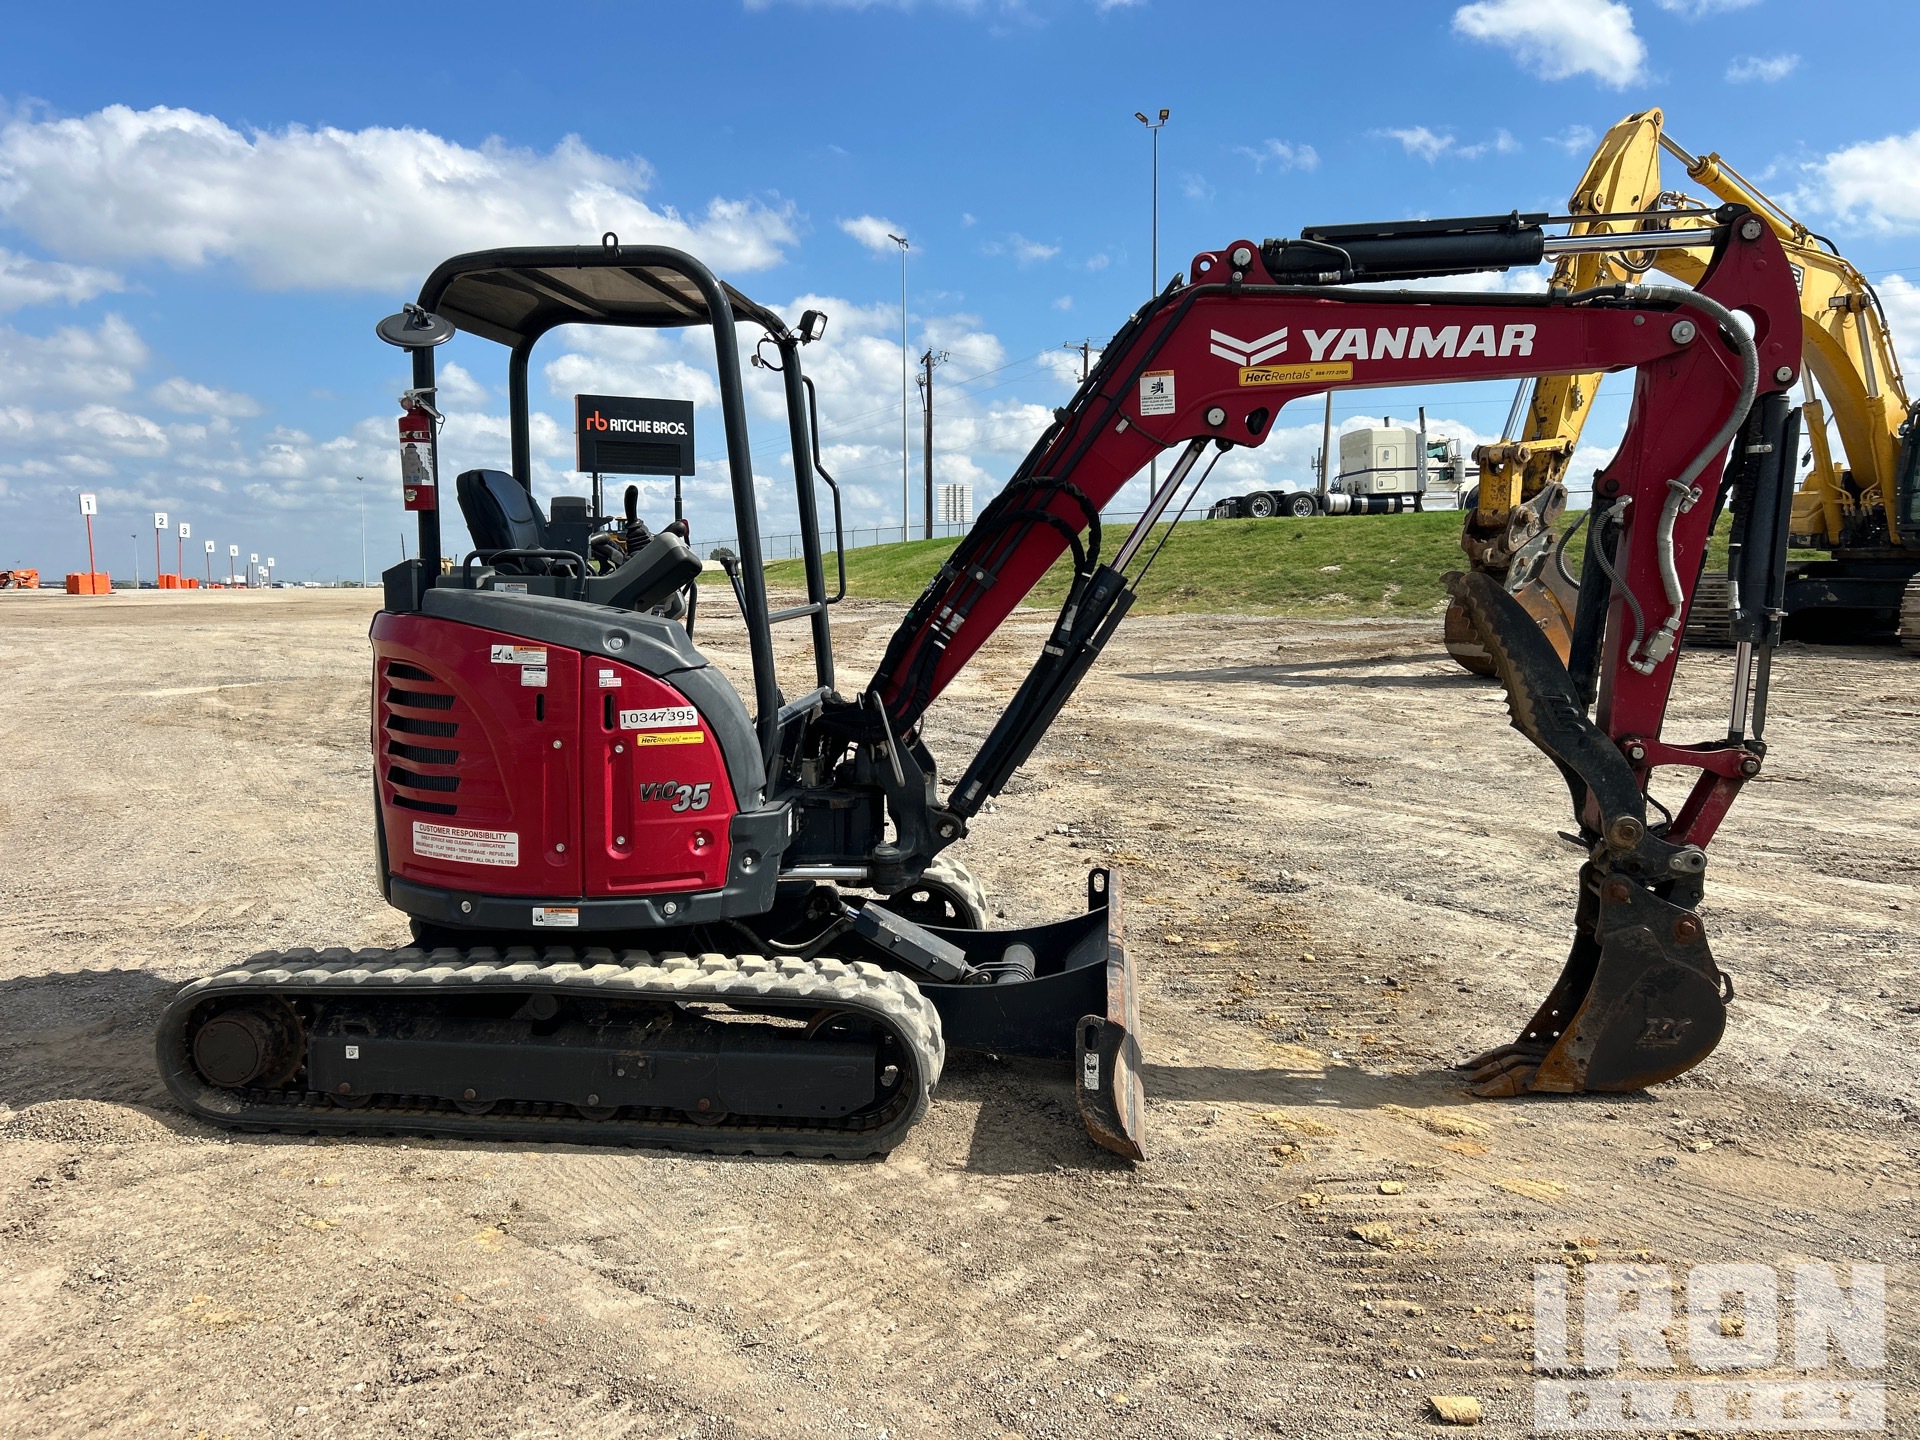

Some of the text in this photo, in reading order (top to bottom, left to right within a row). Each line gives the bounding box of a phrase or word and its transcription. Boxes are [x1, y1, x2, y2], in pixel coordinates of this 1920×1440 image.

[1302, 324, 1537, 362] YANMAR
[586, 410, 688, 435] rb RITCHIE BROS.
[86, 501, 91, 511] 1
[158, 518, 165, 526] 2
[621, 710, 694, 724] 10347395
[419, 824, 508, 841] CUSTOMER RESPONSIBILITY
